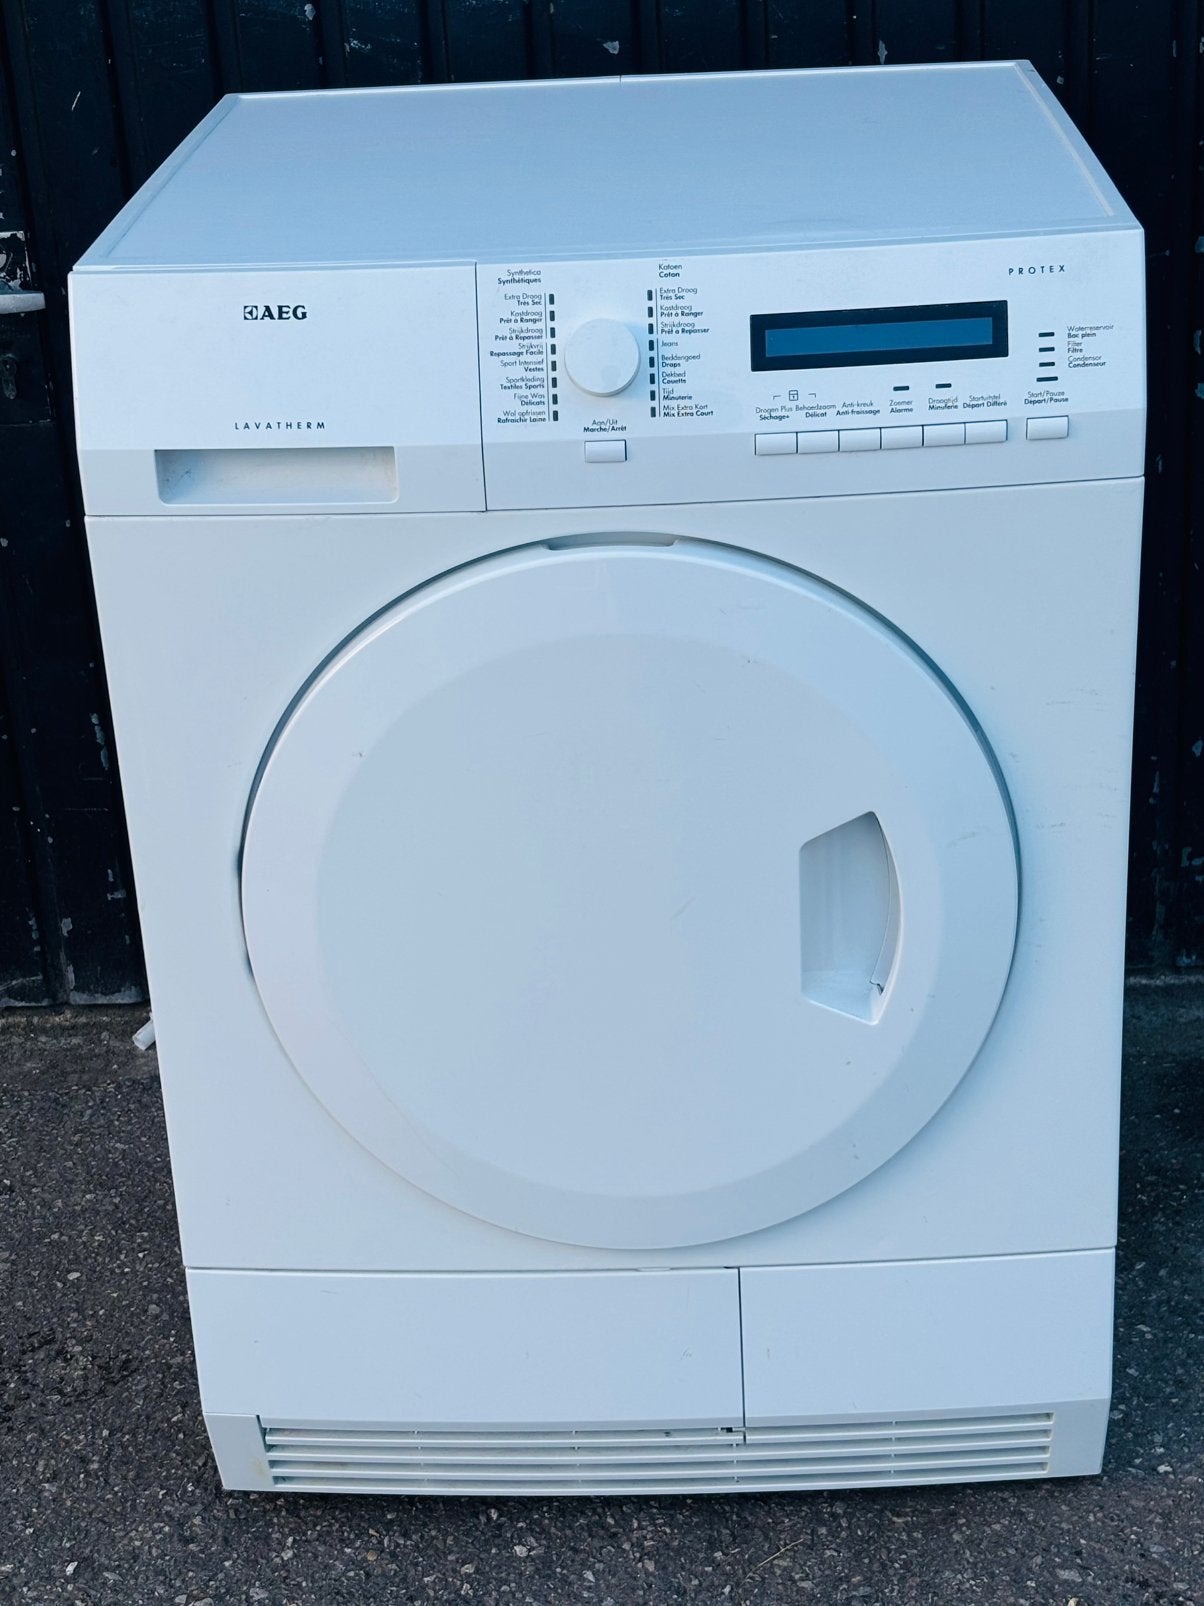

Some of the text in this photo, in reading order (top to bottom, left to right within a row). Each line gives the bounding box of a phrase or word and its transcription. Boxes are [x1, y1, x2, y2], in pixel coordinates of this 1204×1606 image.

[1008, 264, 1065, 276] PROTEX
[260, 305, 307, 320] AEG
[661, 353, 701, 362] Beddengoed
[518, 358, 544, 366] Intensief
[842, 400, 874, 408] Anti-kreuk
[755, 406, 779, 414] Drogen
[836, 408, 881, 416] Anti-froissage
[234, 421, 325, 431] LAVATHERM
[592, 418, 618, 426] Aan/Uit
